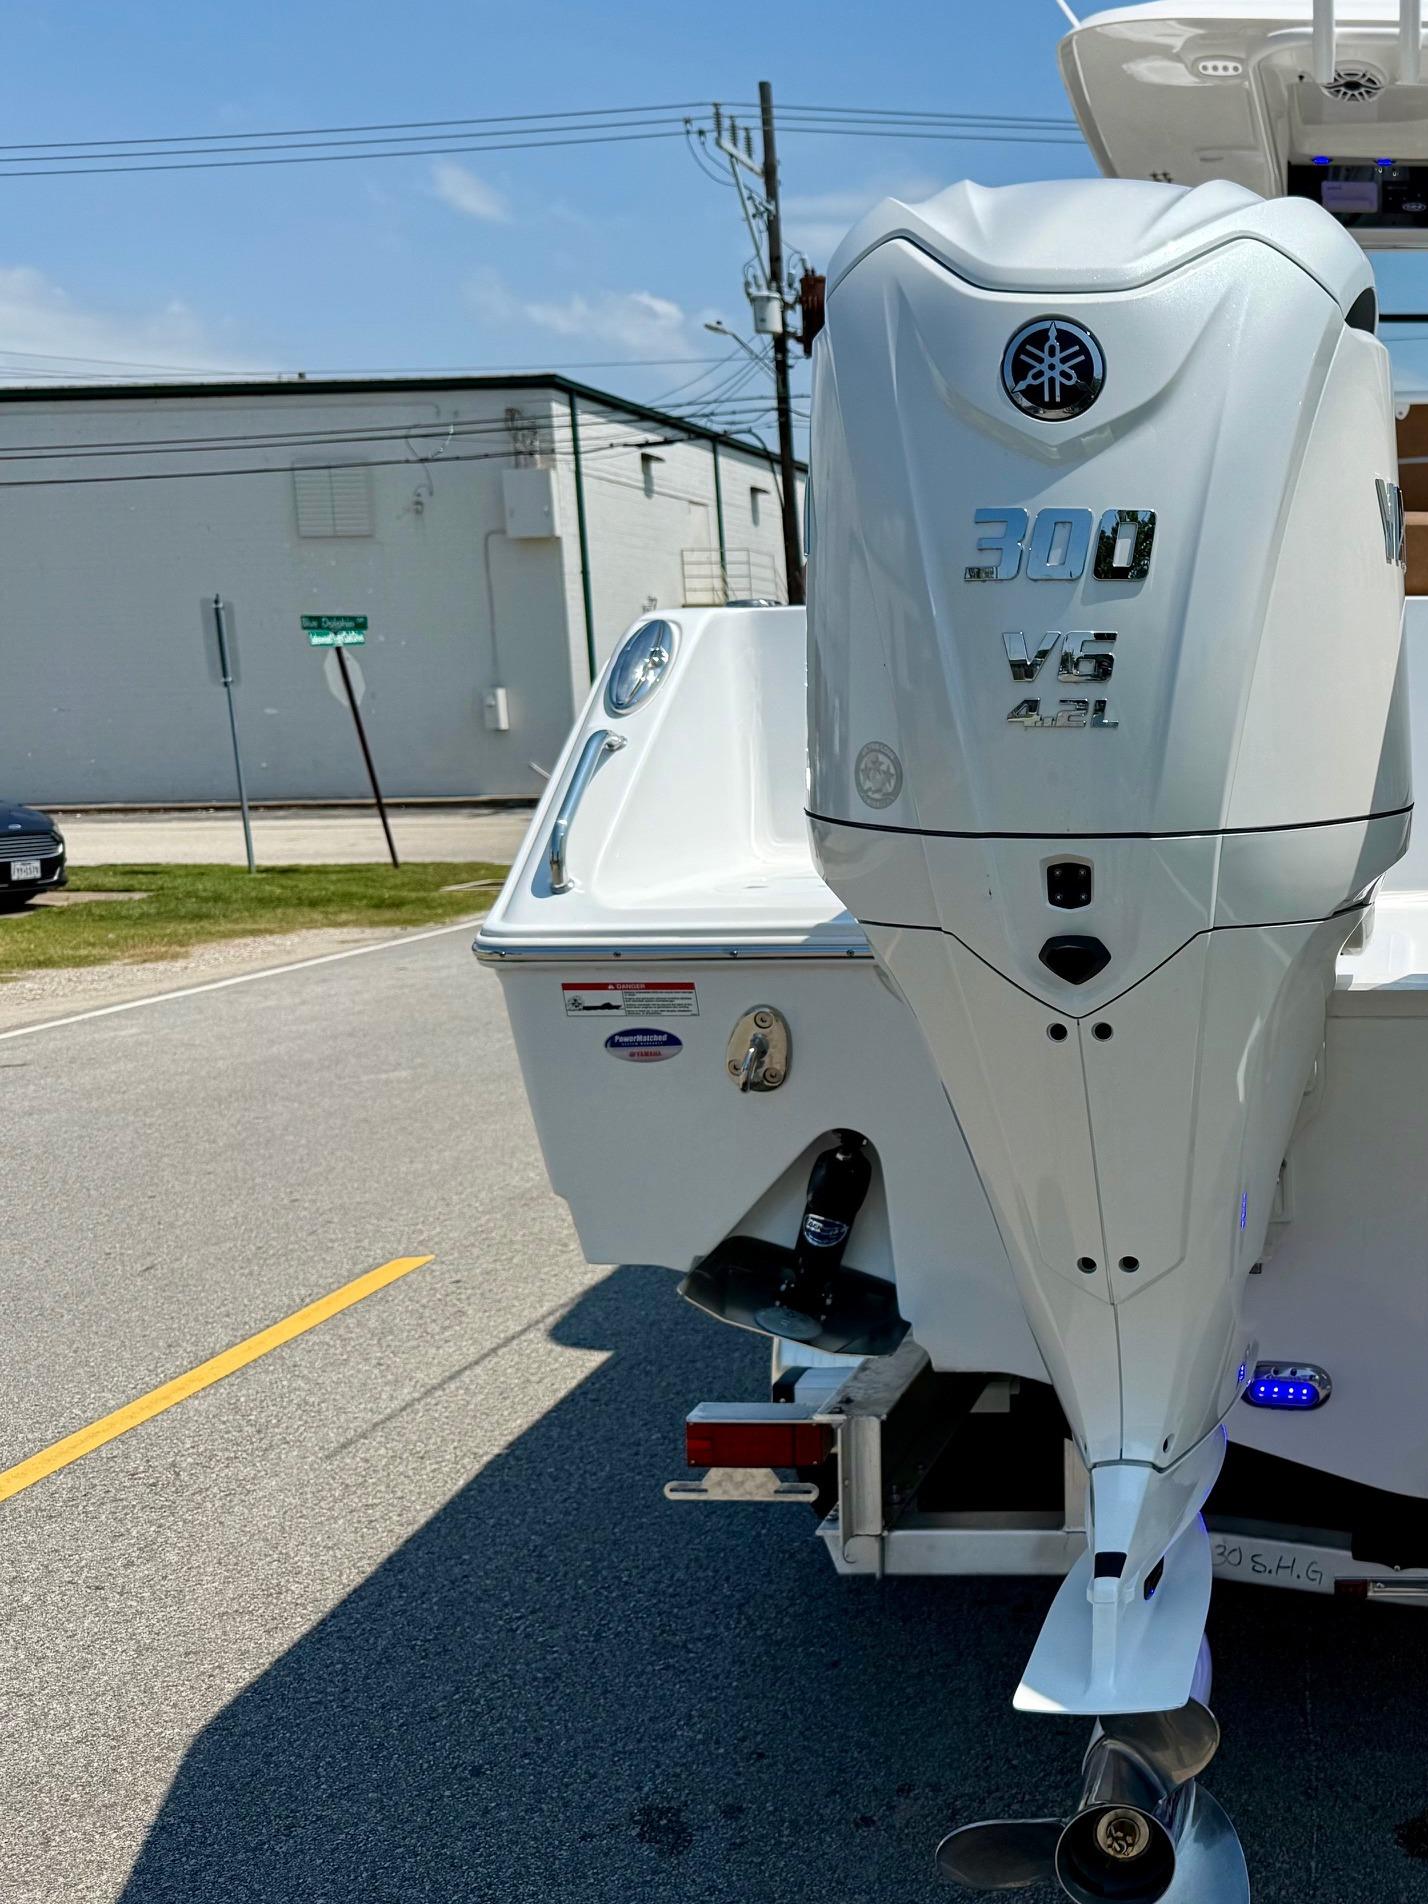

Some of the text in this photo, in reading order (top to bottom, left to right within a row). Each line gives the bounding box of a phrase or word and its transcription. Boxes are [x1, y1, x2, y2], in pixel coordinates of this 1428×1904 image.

[964, 508, 1157, 581] 300
[1002, 631, 1118, 682] V6
[1007, 698, 1119, 728] 4.2L
[615, 1034, 668, 1042] PowerMatched
